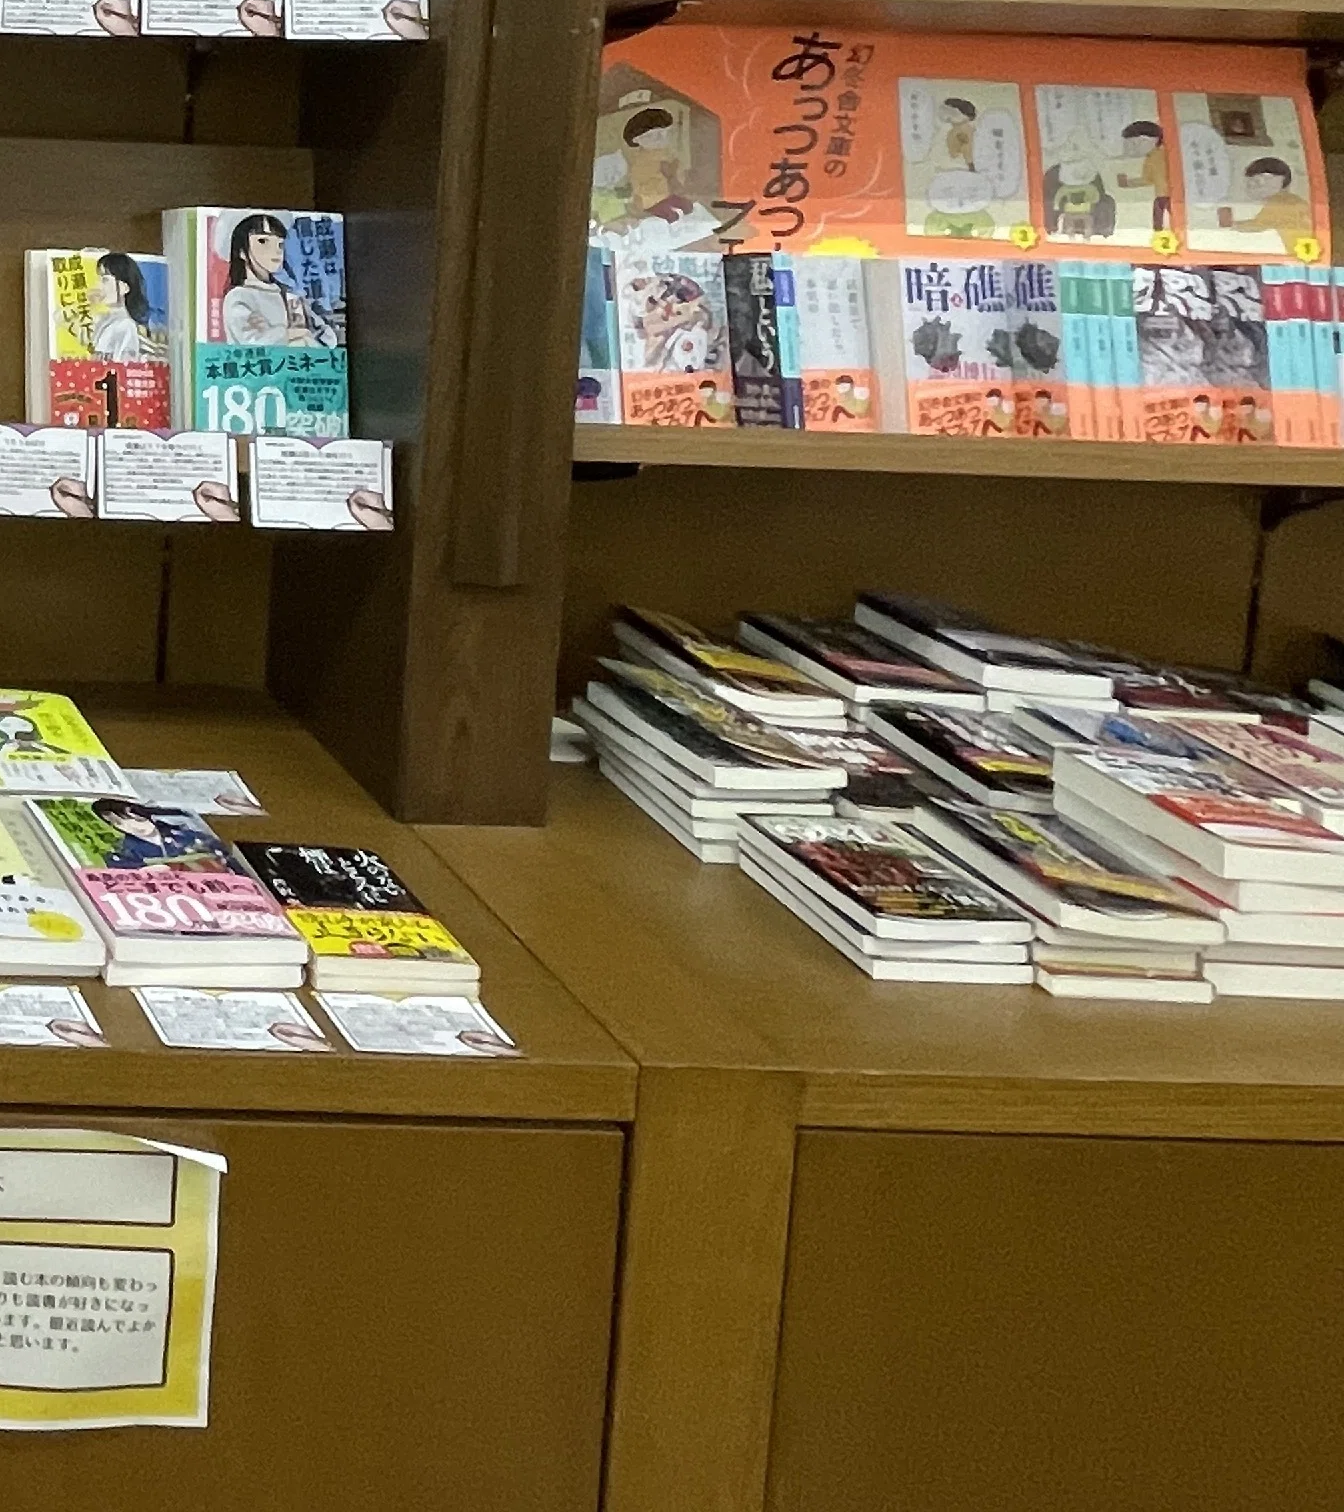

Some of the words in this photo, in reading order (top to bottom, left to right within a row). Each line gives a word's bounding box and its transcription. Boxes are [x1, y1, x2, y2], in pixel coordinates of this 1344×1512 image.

[904, 262, 1005, 314] 暗礁
[95, 371, 118, 430] 1
[202, 384, 287, 435] 180
